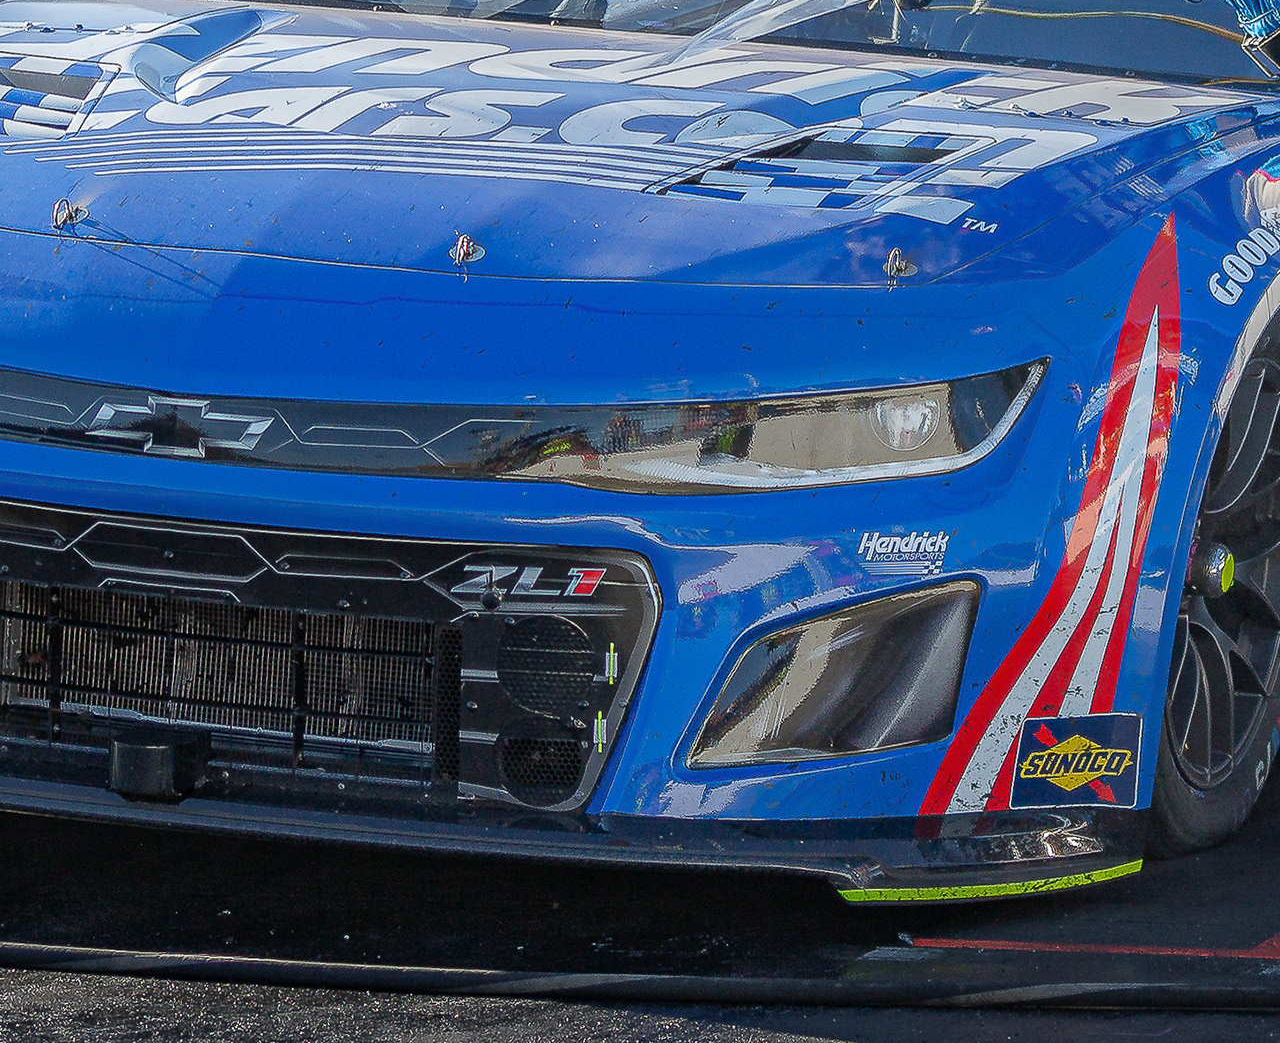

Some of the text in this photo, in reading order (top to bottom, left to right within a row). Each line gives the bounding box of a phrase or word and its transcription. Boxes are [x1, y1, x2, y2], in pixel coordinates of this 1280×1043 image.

[963, 216, 998, 237] TM
[857, 531, 951, 558] Hendrick
[871, 551, 946, 563] MOTORSPORTS
[449, 564, 607, 598] ZL1
[1024, 751, 1128, 779] SUNOCO
